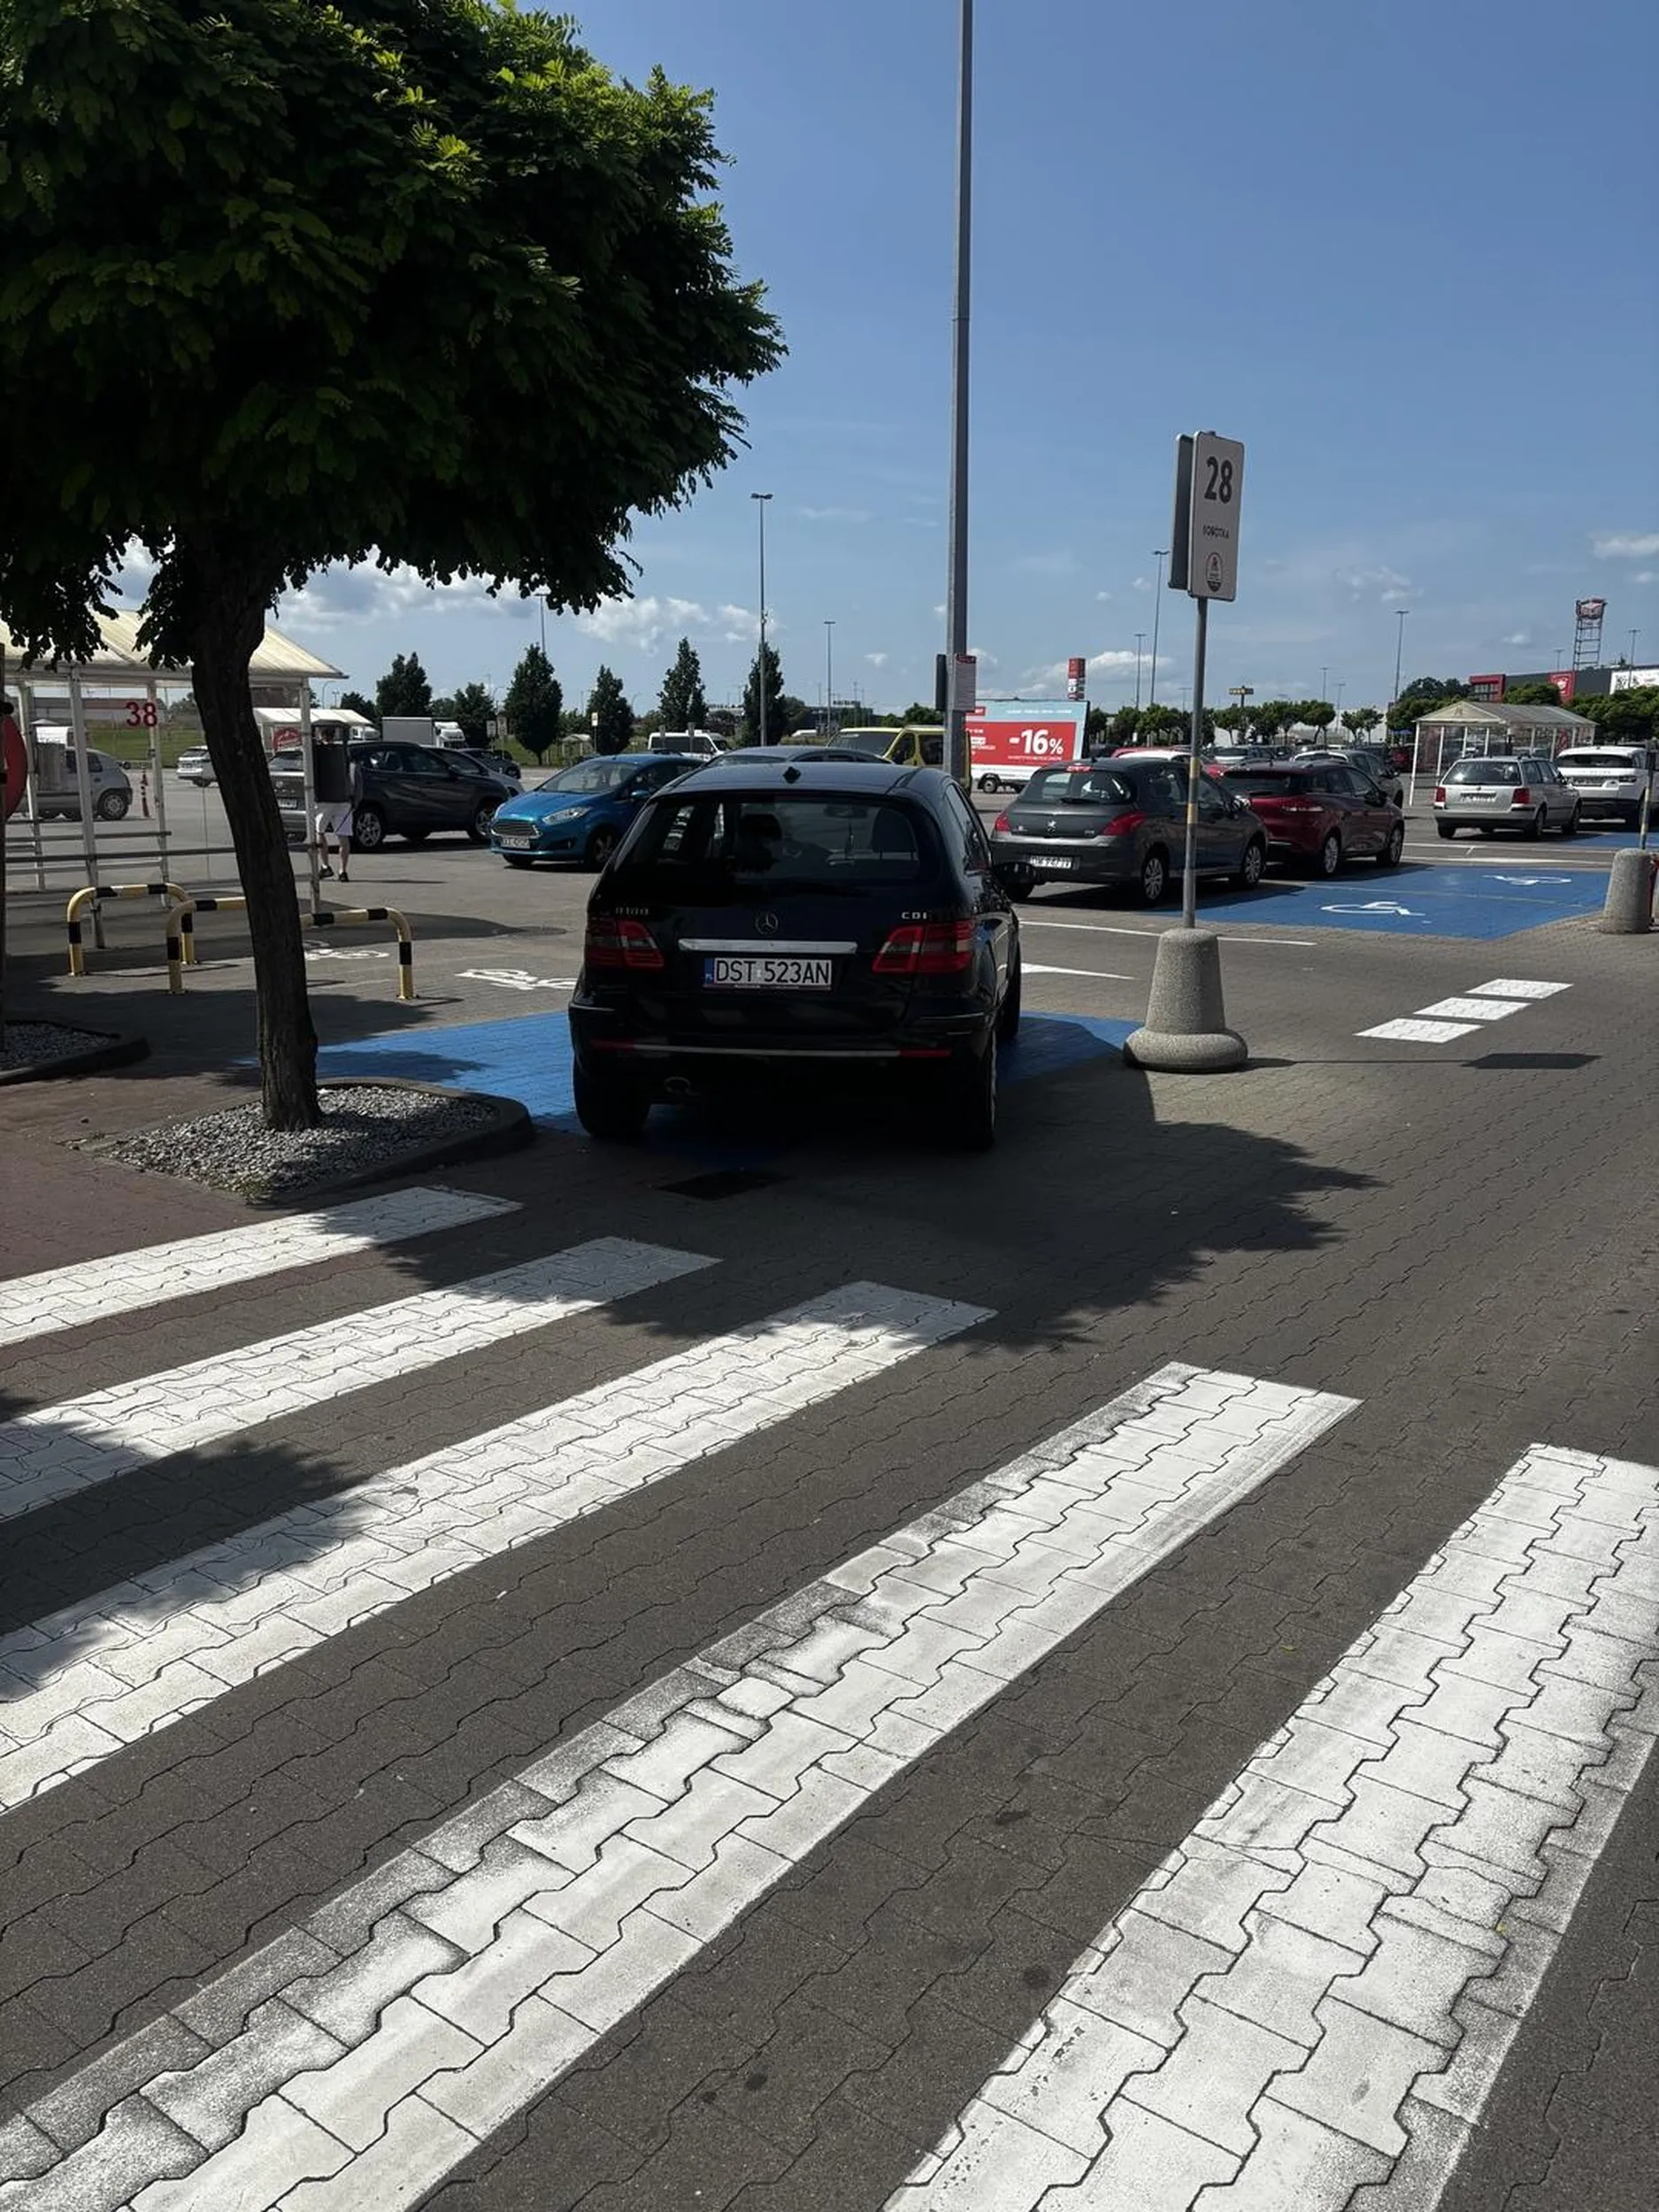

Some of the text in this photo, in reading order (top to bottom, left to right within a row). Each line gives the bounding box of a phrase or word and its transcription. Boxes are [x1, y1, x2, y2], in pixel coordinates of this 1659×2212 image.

[1204, 456, 1233, 504] 28
[126, 702, 157, 726] 38
[1009, 728, 1064, 755] -16%
[717, 959, 830, 984] DST 523AN
